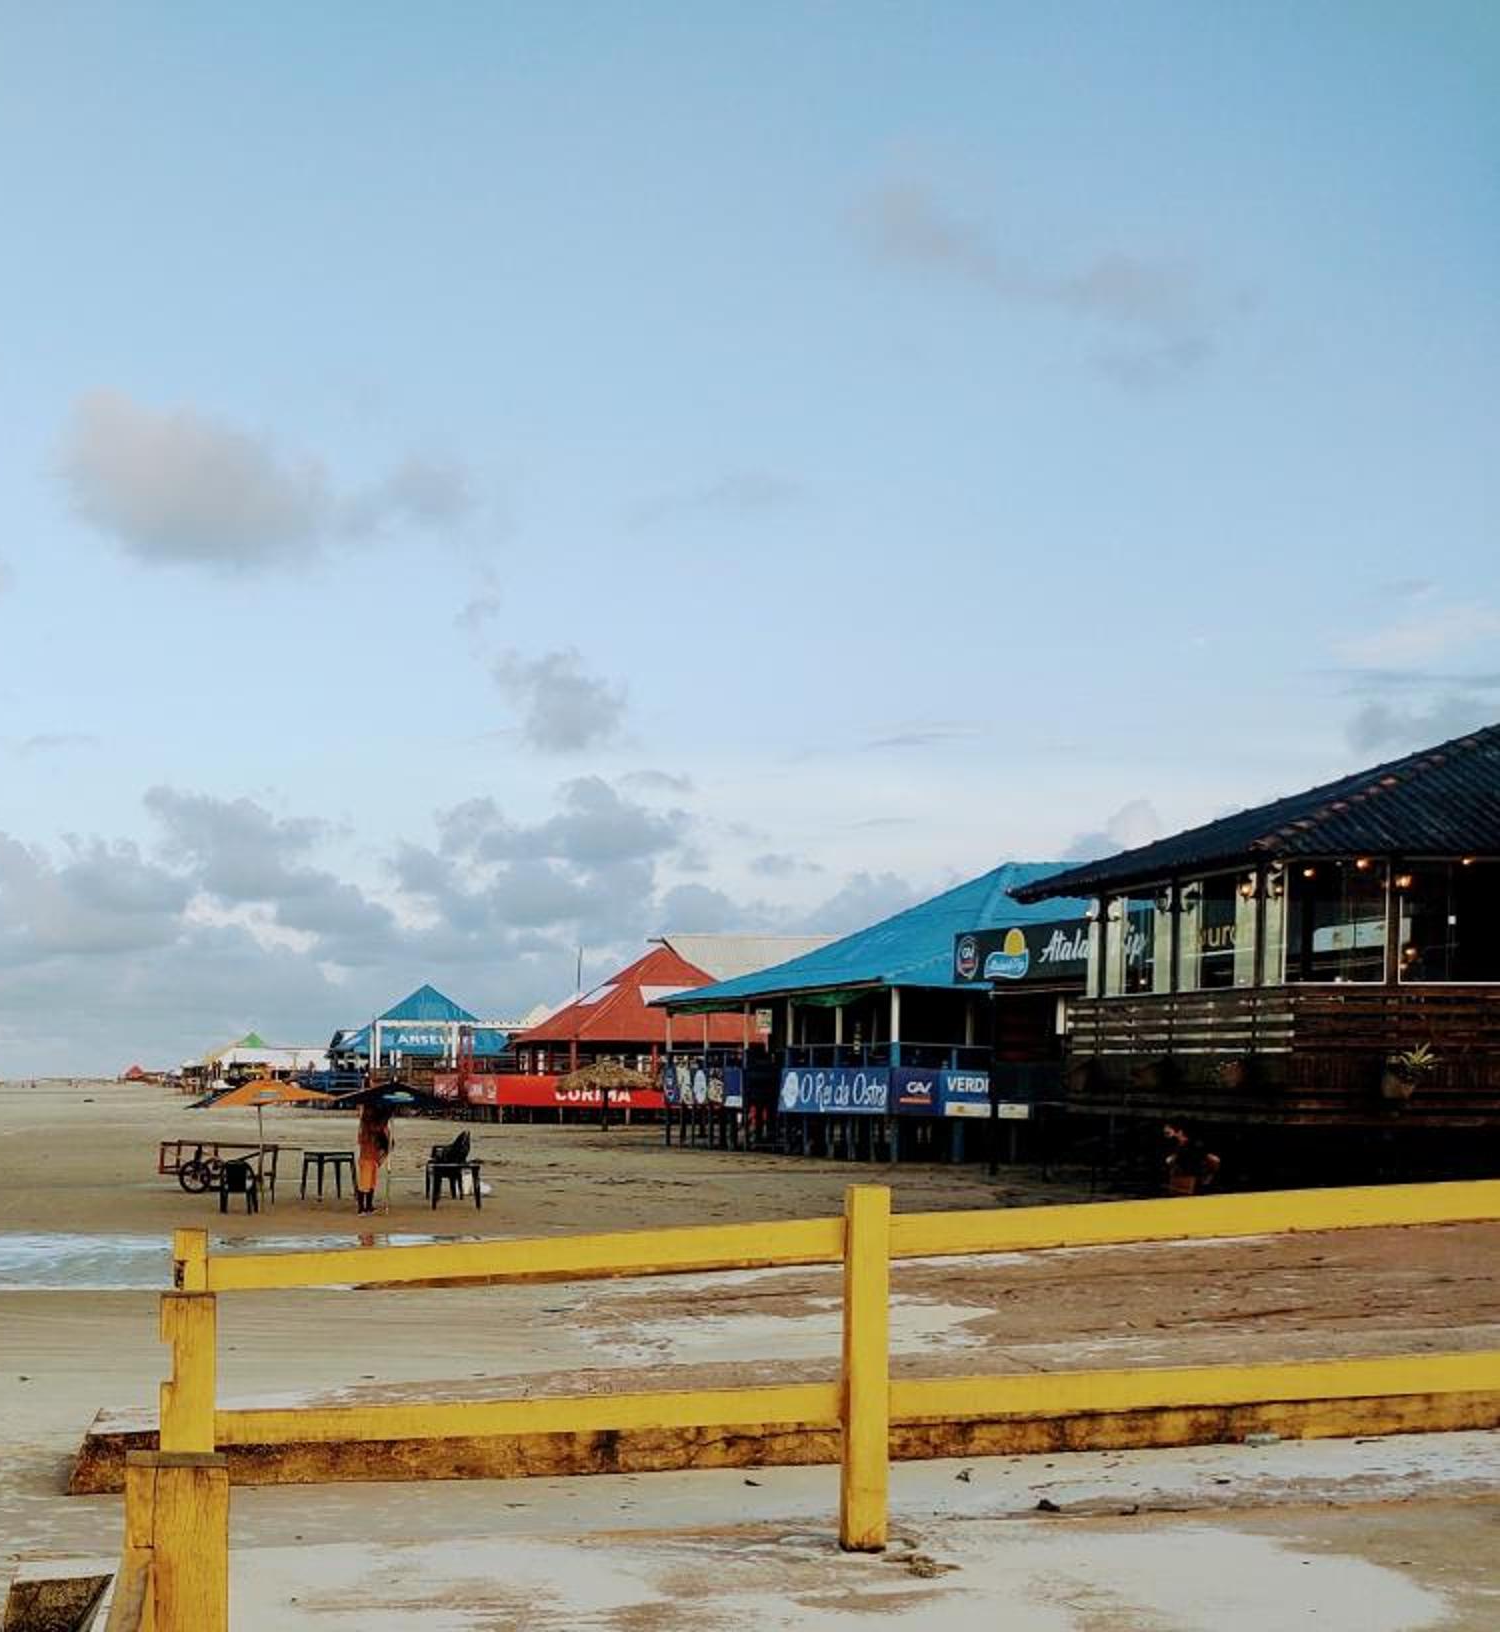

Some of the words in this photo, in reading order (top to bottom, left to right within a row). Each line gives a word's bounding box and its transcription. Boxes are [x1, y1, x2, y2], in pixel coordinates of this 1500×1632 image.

[1037, 927, 1093, 963] Atala
[801, 1073, 812, 1104] O
[815, 1072, 834, 1106] Rei
[853, 1073, 887, 1106] Ostra
